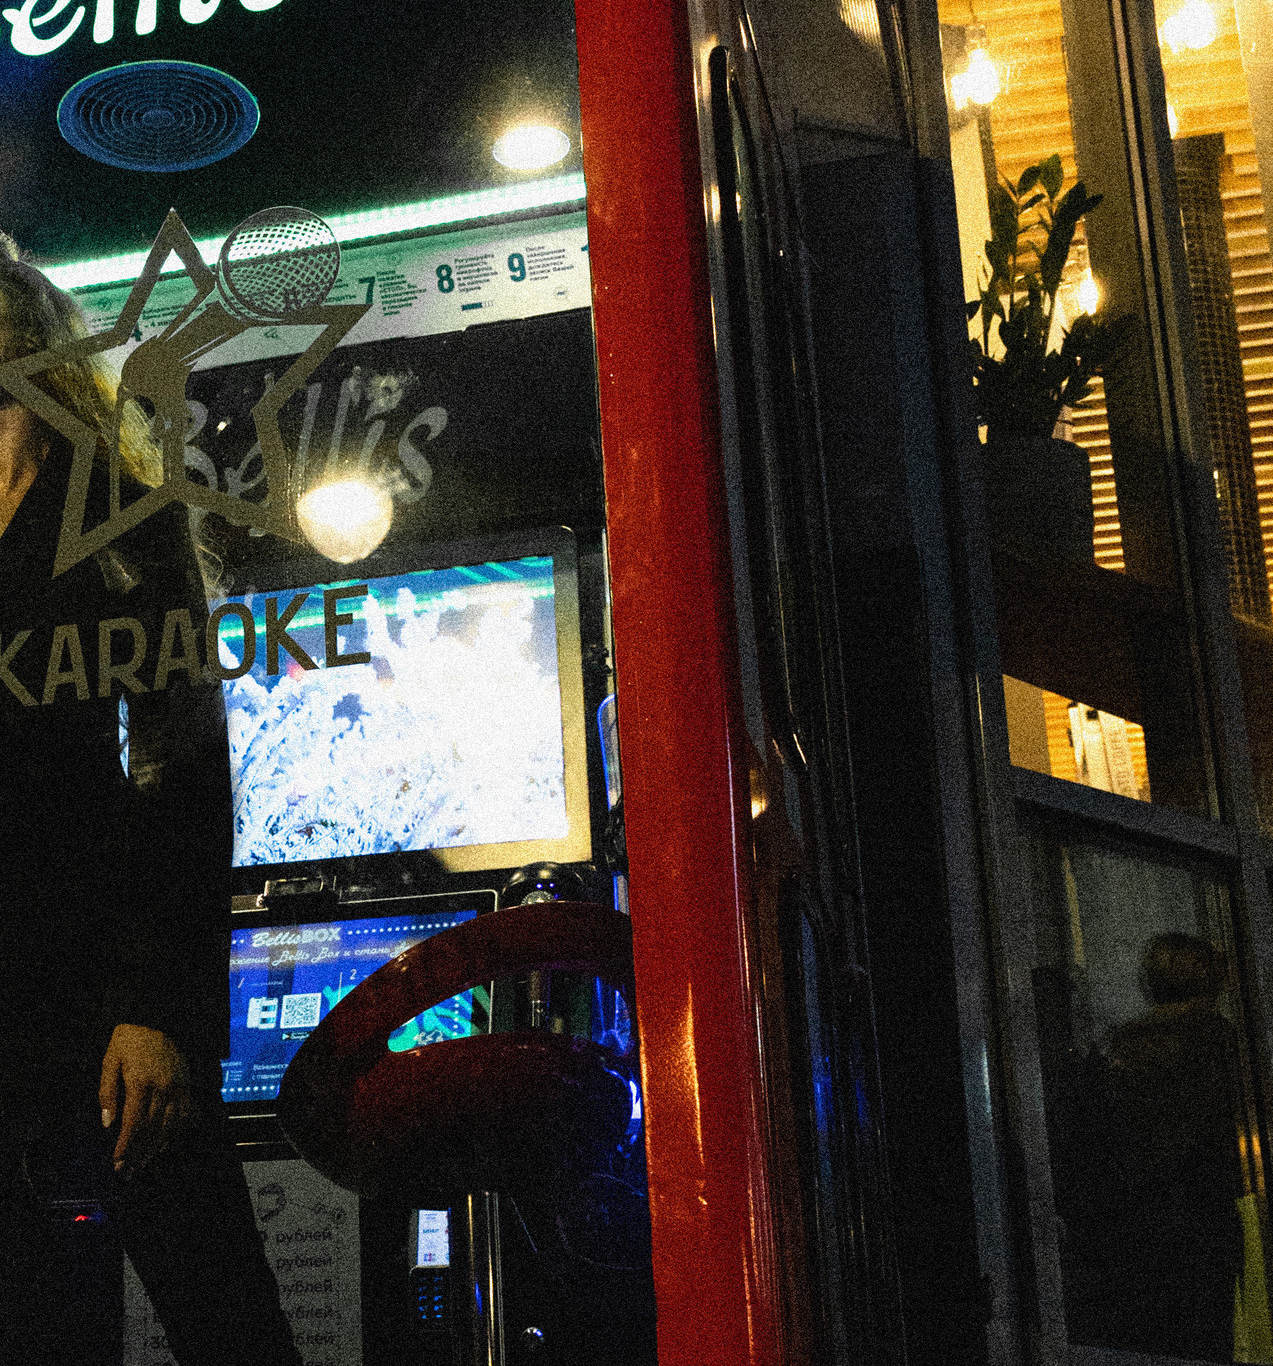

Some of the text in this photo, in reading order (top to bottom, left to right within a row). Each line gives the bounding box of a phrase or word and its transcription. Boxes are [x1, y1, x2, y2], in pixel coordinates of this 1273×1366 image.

[435, 263, 455, 294] 8
[507, 252, 526, 282] 9
[358, 276, 375, 304] 7
